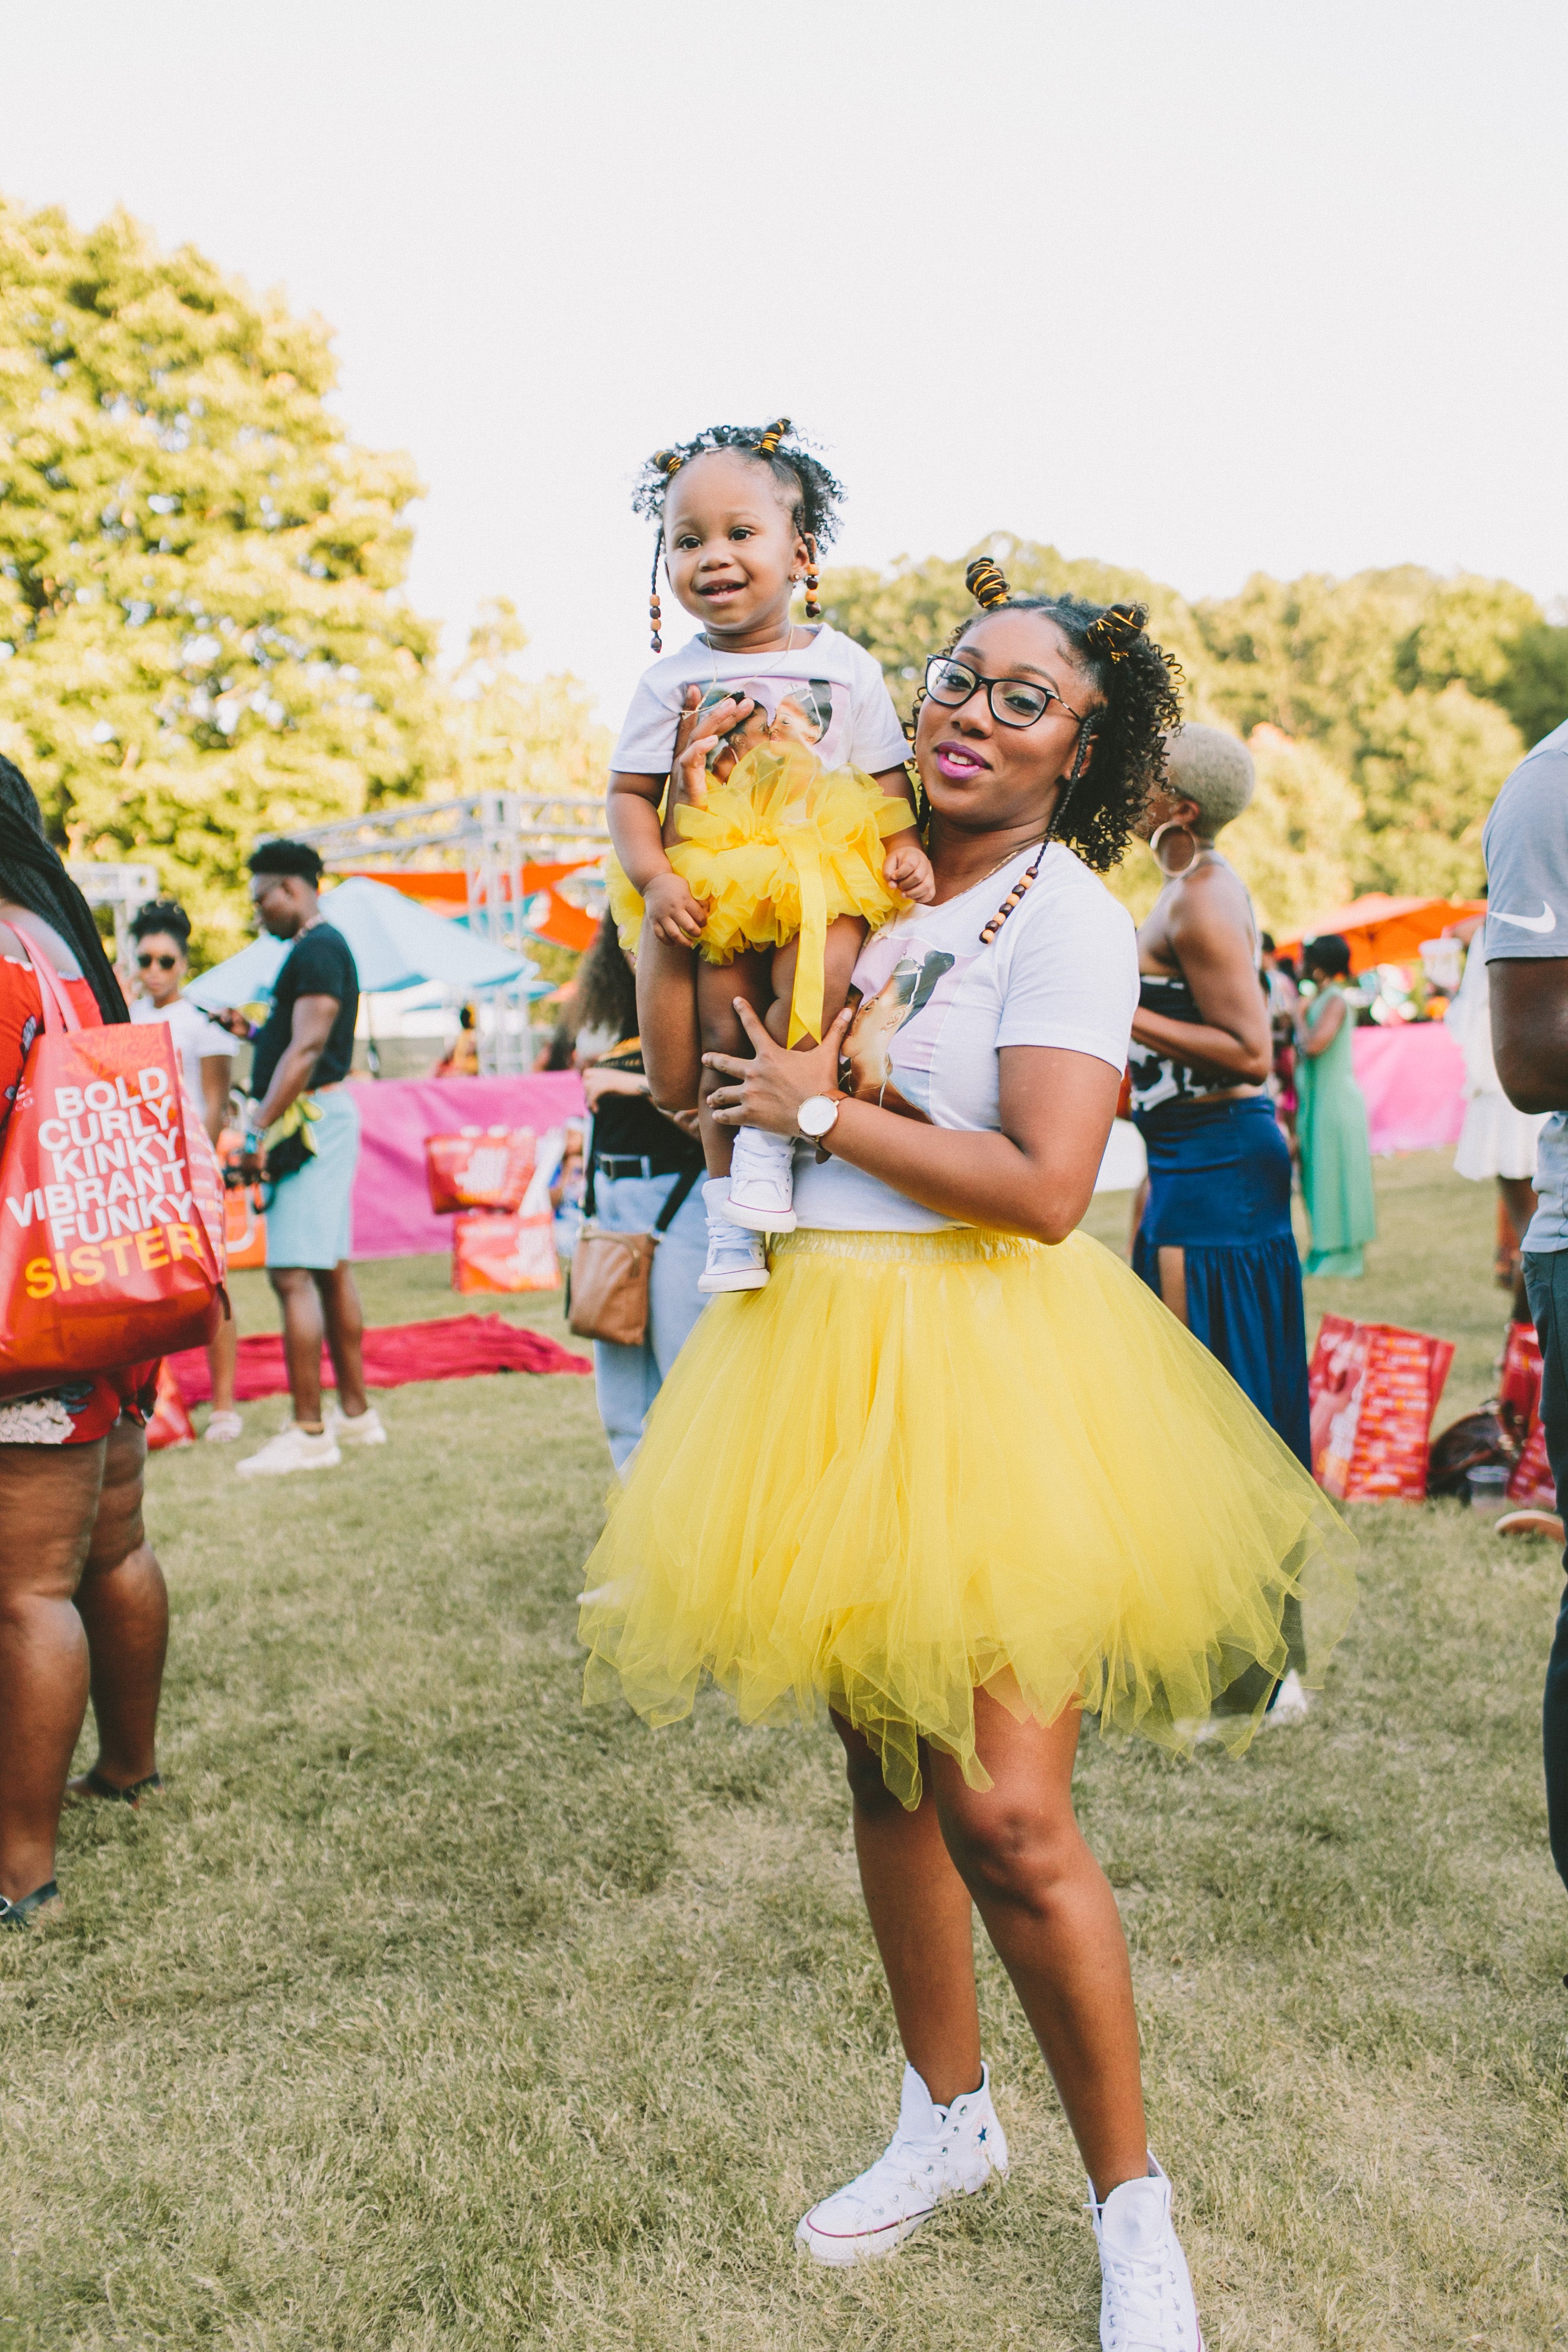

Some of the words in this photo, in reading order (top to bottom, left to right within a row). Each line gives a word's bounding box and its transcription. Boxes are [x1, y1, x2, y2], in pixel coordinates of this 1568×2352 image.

[55, 1067, 168, 1119] BOLD
[38, 1095, 172, 1152] CURLY
[52, 1126, 179, 1183] KINKY
[6, 1159, 186, 1228] VIBRANT
[50, 1191, 192, 1250] FUNKY
[25, 1223, 204, 1299] SISTER
